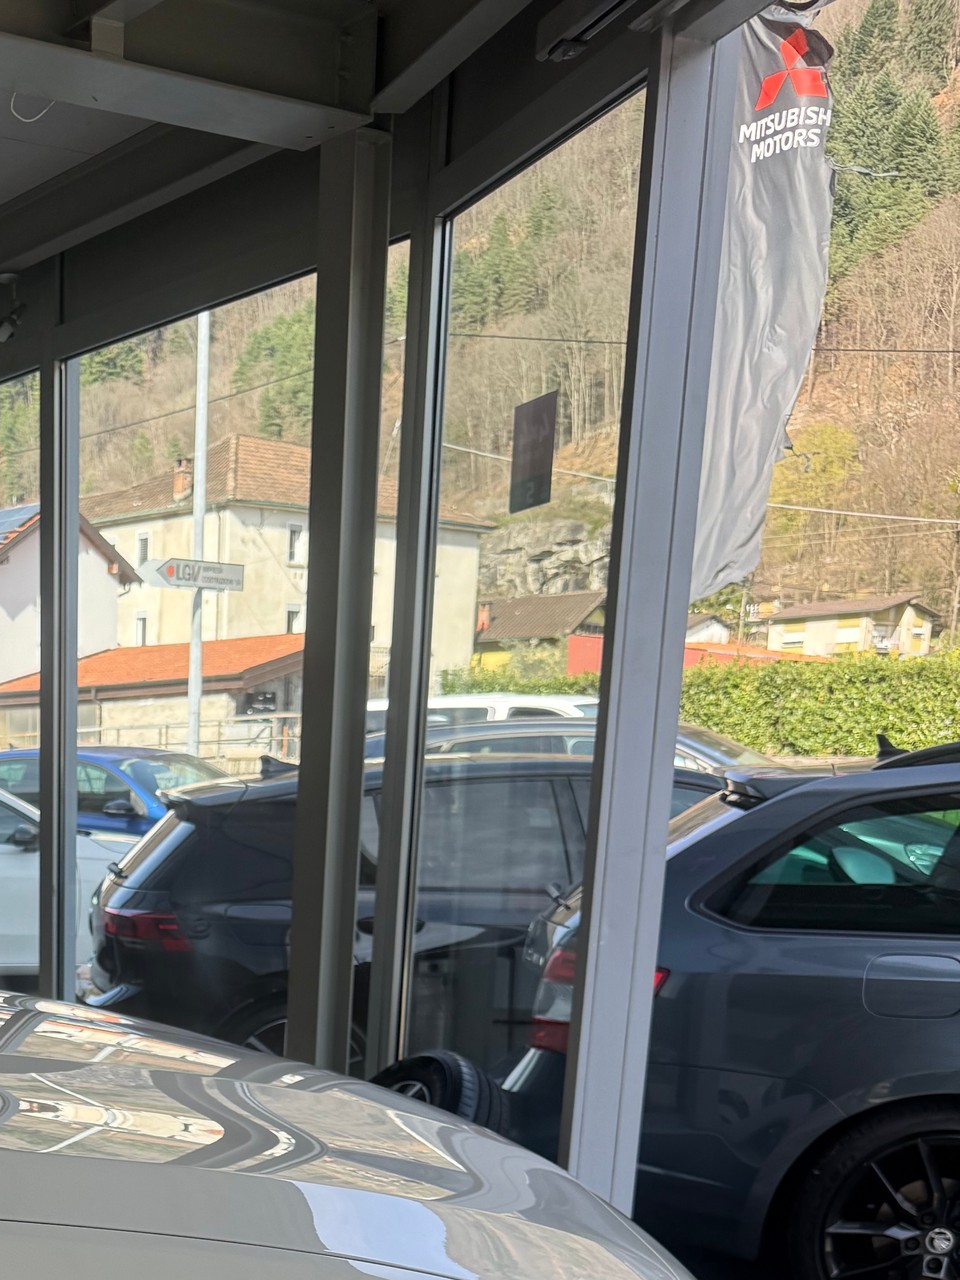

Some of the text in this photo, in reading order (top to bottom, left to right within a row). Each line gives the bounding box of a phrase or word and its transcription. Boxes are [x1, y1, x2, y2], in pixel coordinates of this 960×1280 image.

[738, 106, 832, 144] MITSUBISH
[751, 128, 822, 163] MOTORS
[175, 563, 202, 582] LGV
